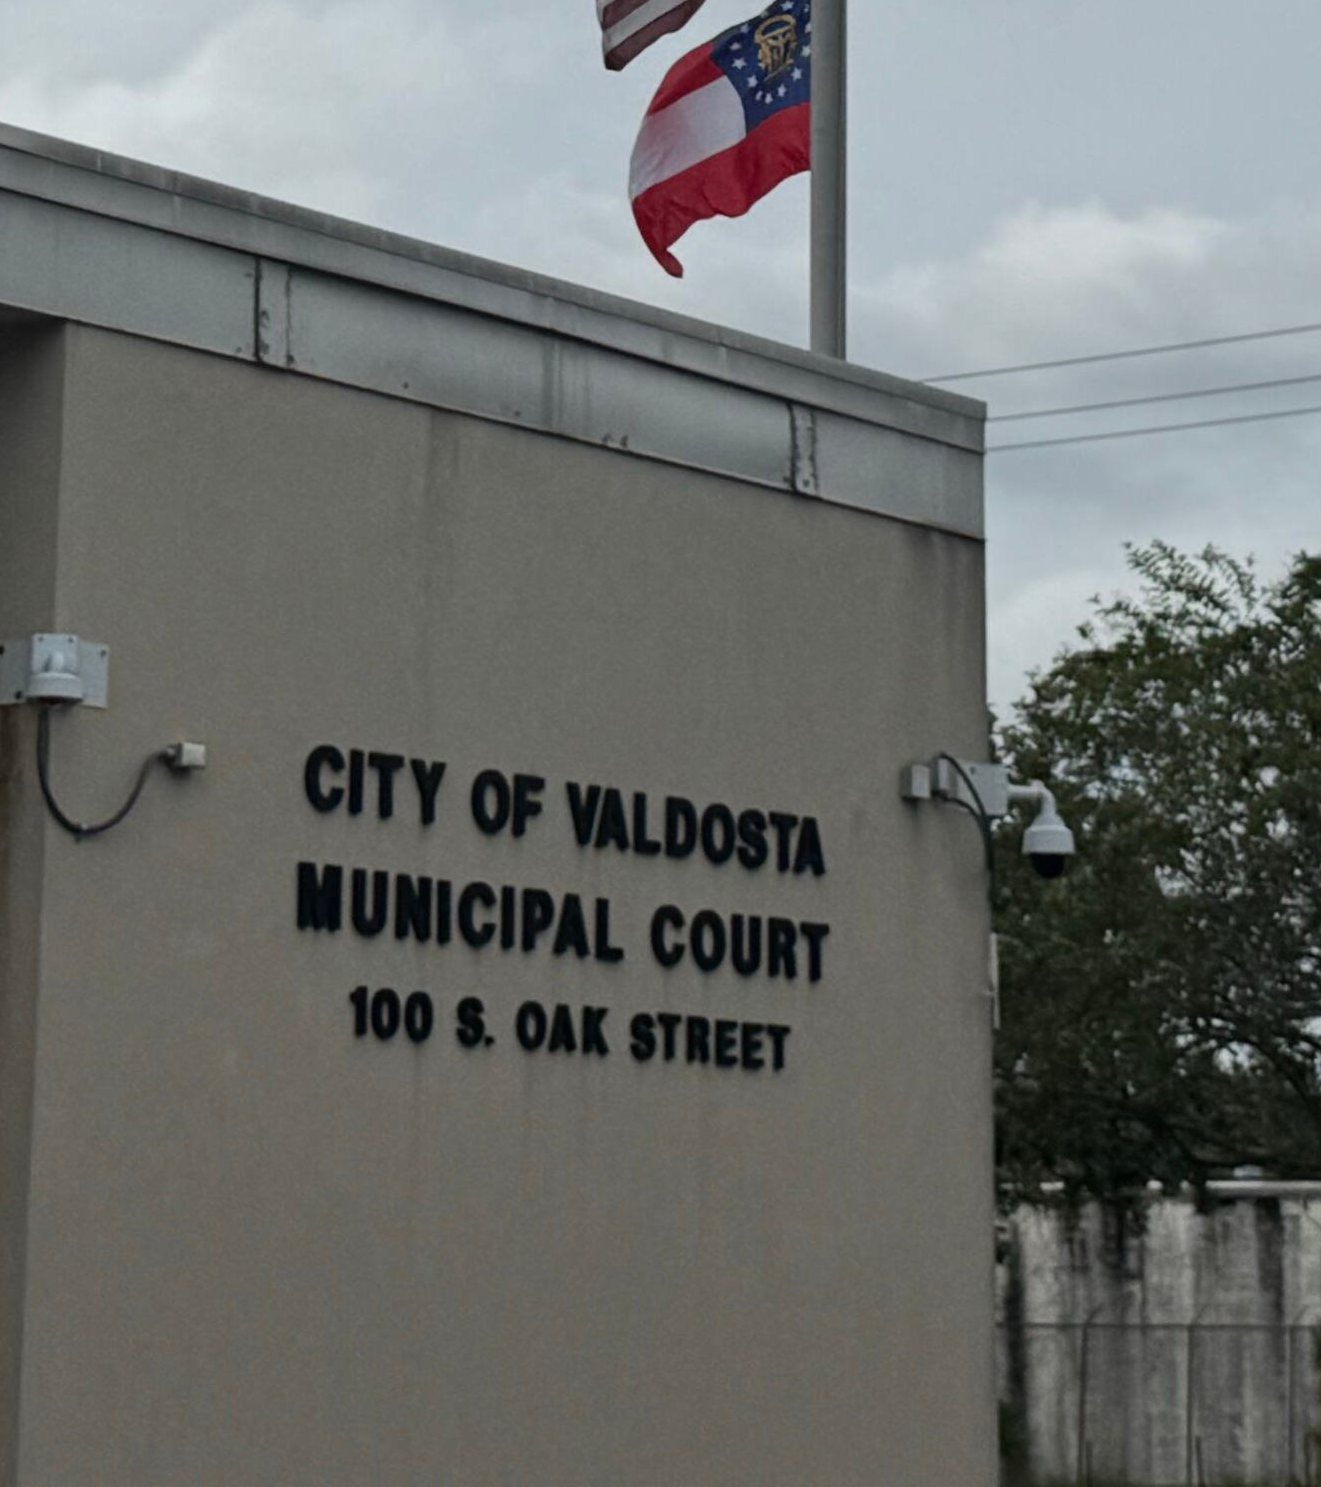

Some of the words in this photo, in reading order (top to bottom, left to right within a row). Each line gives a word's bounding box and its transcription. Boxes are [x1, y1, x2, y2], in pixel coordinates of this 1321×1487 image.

[304, 745, 446, 829] CITY
[470, 770, 545, 839] OF
[566, 782, 826, 879] VALDOSTA
[296, 862, 624, 965] MUNICIPAL
[650, 905, 830, 985] COURT
[349, 986, 433, 1047] 100
[456, 997, 494, 1050] S.
[515, 1001, 609, 1058] OAK
[630, 1013, 791, 1073] STREET
